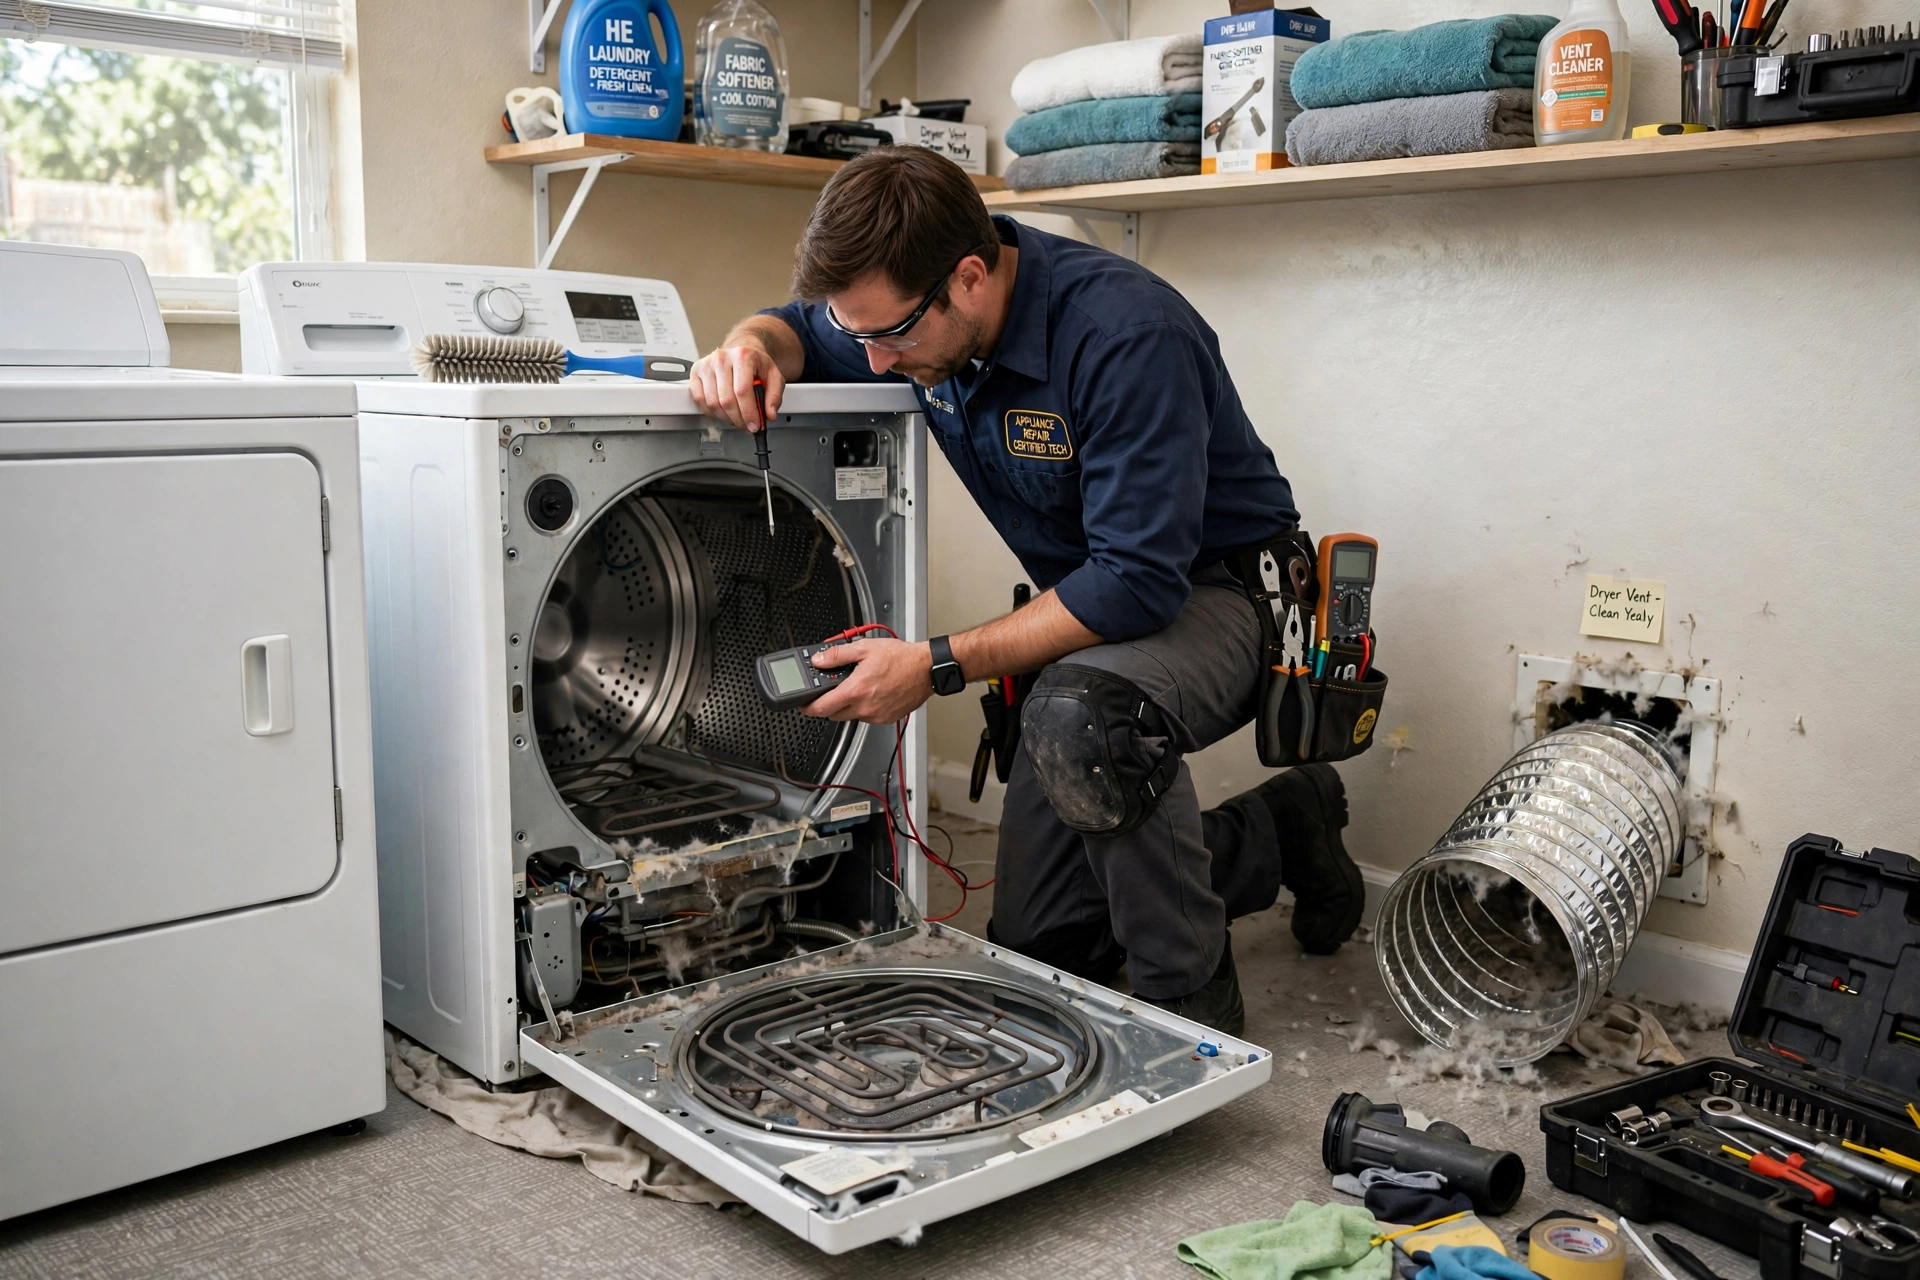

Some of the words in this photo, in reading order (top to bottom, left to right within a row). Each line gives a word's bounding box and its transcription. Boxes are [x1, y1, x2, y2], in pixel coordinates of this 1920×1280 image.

[605, 18, 634, 43] HE
[589, 45, 650, 65] LAUNDRY
[1560, 43, 1593, 60] VENT
[725, 54, 766, 73] FABRIC
[1549, 57, 1604, 76] CLEANER
[589, 66, 652, 83] DETERGENT
[717, 71, 775, 91] SOFTENER
[596, 80, 625, 92] FRESH
[720, 92, 744, 106] COOL
[745, 93, 777, 109] COTTON
[1015, 415, 1054, 429] APPLIANCE
[1023, 428, 1050, 441] REPAIR
[1014, 440, 1046, 453] CERTIFIED
[1048, 443, 1067, 454] TECH
[1590, 585, 1621, 604] Dryer
[1626, 588, 1651, 603] Vent
[1589, 604, 1619, 619] Clean
[1625, 607, 1654, 629] Yealy
